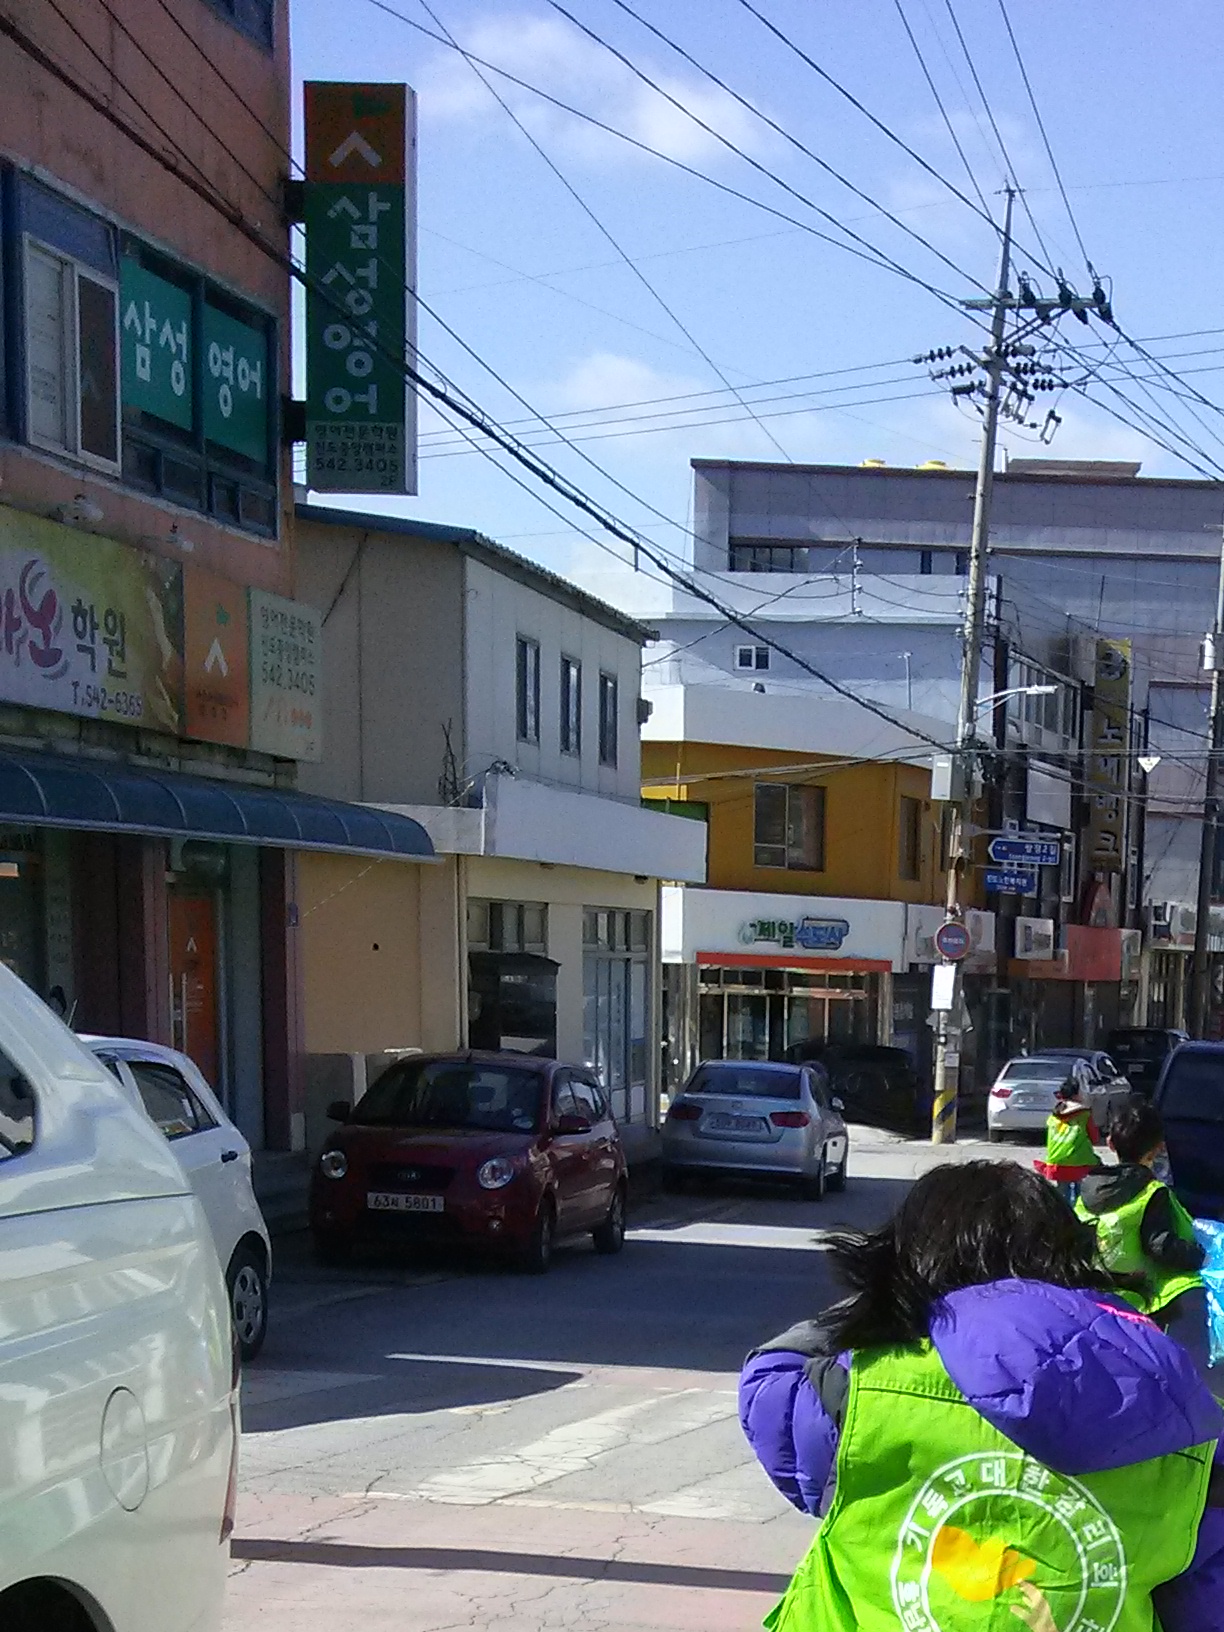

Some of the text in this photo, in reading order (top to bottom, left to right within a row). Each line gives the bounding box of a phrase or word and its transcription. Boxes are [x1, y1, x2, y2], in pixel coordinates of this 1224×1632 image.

[123, 300, 187, 396] 삼성
[208, 341, 261, 418] 영어
[71, 598, 127, 679] 학원
[907, 1458, 1118, 1587] 기독교대한감리회
